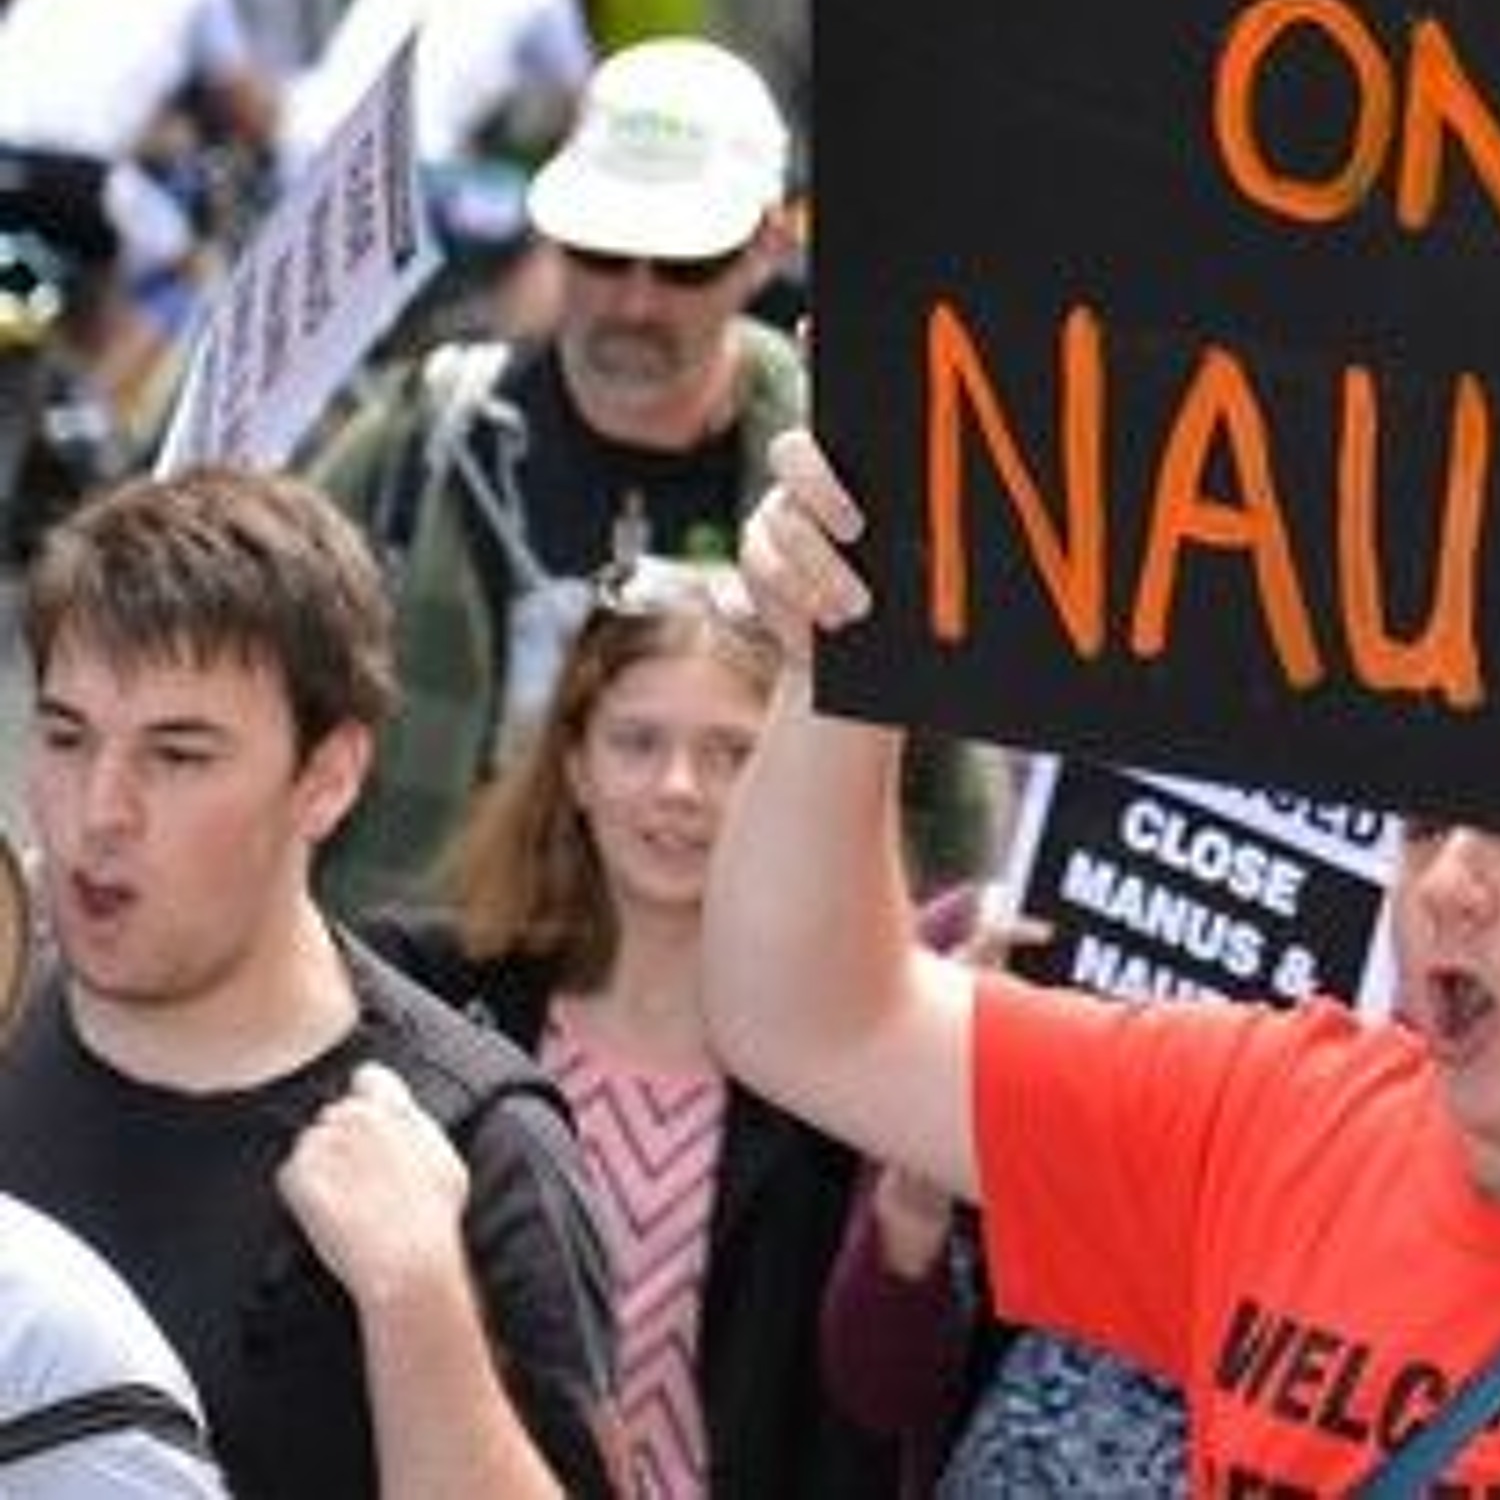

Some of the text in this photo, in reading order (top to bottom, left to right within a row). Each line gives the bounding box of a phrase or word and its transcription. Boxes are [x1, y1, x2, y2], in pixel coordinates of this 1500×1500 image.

[1121, 797, 1309, 918] CLOSE
[1060, 850, 1320, 1002] MANUS &
